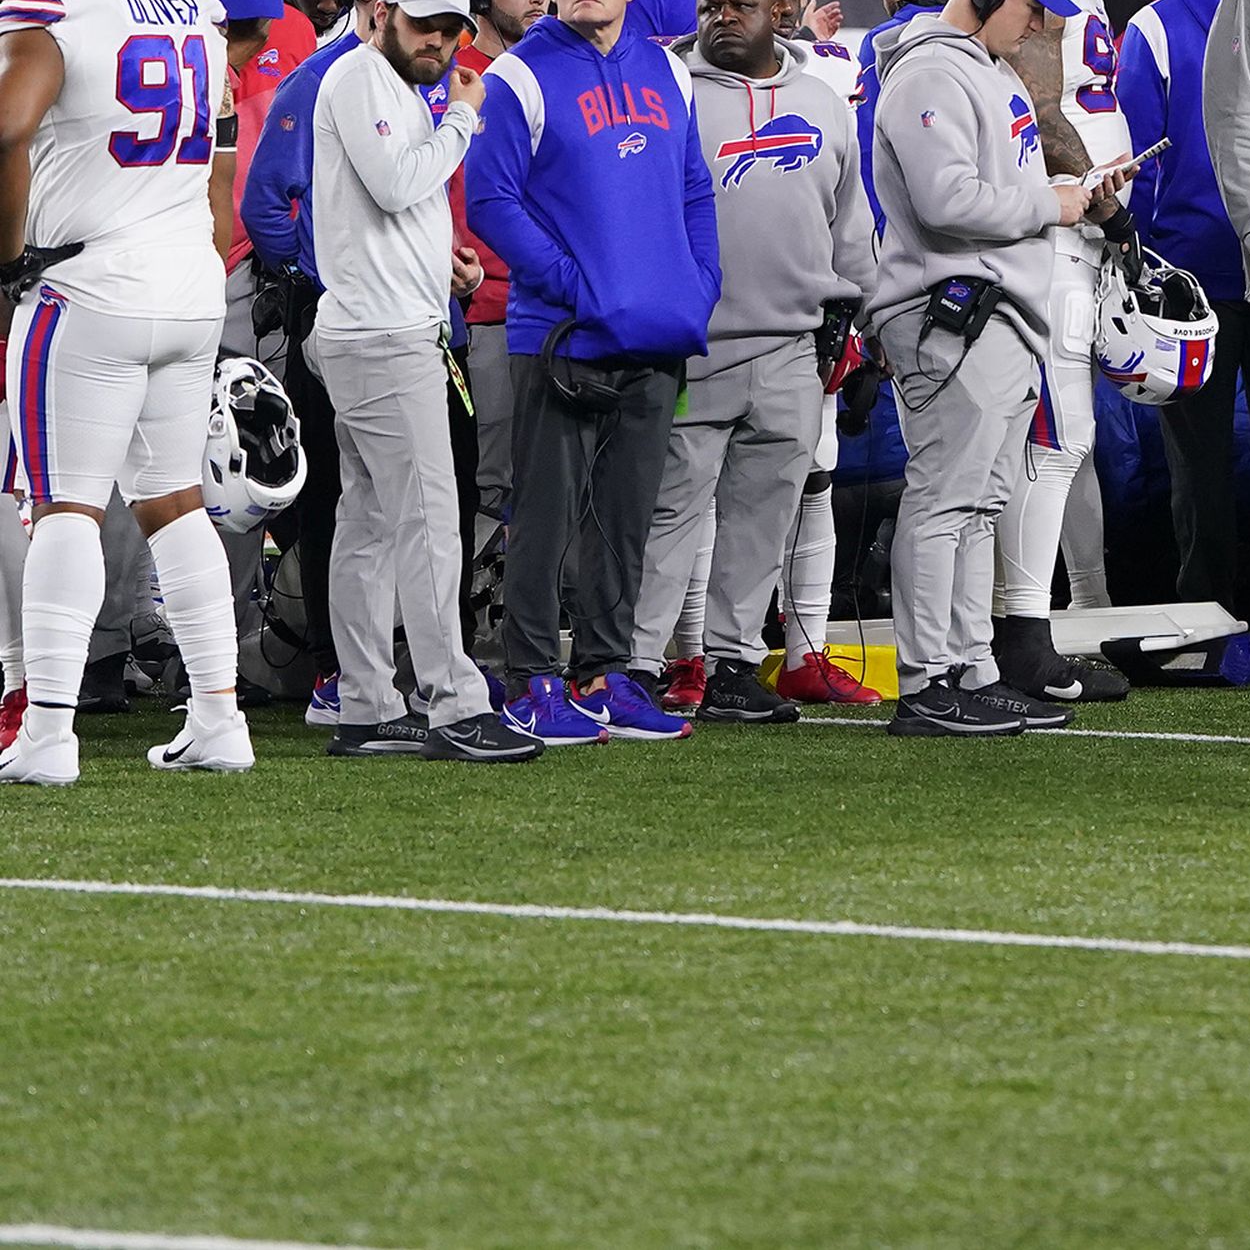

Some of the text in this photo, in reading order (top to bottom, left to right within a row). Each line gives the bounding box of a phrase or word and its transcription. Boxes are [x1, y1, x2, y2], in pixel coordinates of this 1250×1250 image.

[108, 34, 214, 168] 91
[1075, 14, 1118, 114] 9
[576, 82, 671, 138] BILLS
[1173, 328, 1193, 337] LOVE
